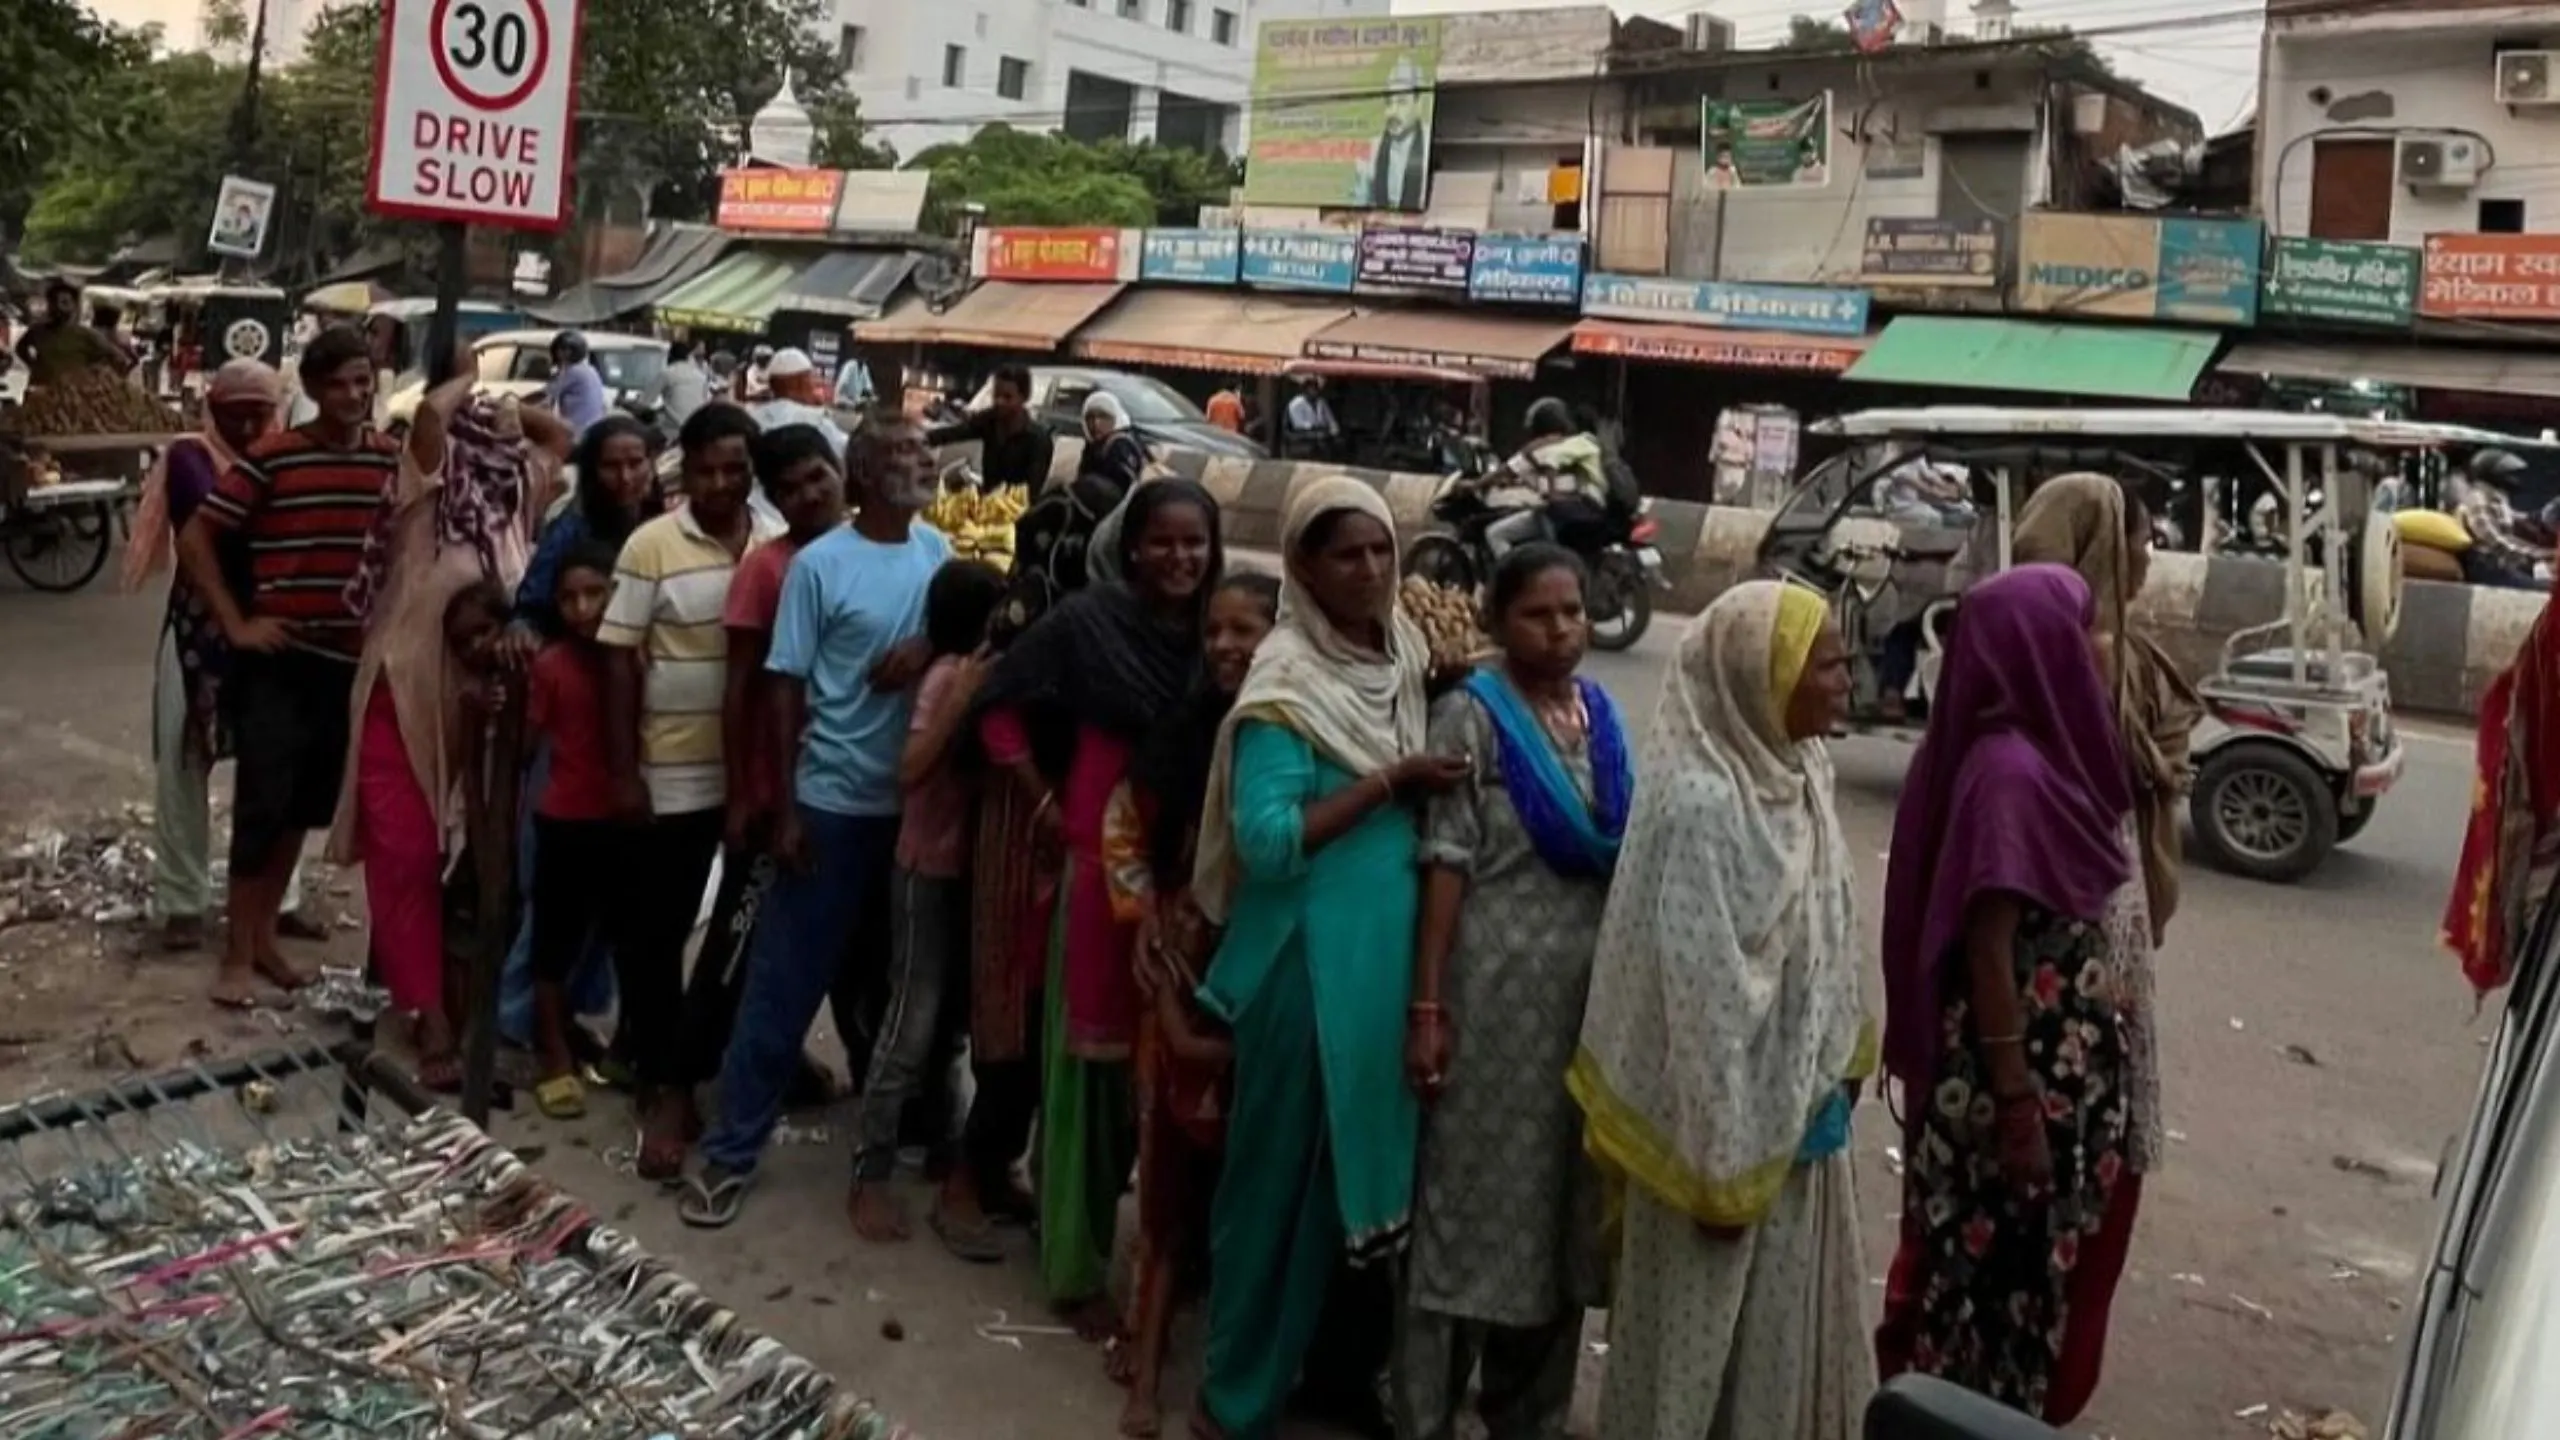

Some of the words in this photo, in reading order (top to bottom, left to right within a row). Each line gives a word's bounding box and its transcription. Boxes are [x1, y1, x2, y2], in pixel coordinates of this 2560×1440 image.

[450, 3, 526, 76] 30
[414, 110, 539, 164] DRIVE
[414, 159, 534, 208] SLOW
[2029, 261, 2148, 290] MEDICO
[2427, 252, 2505, 276] श्याम
[2427, 275, 2539, 304] मेडिकल
